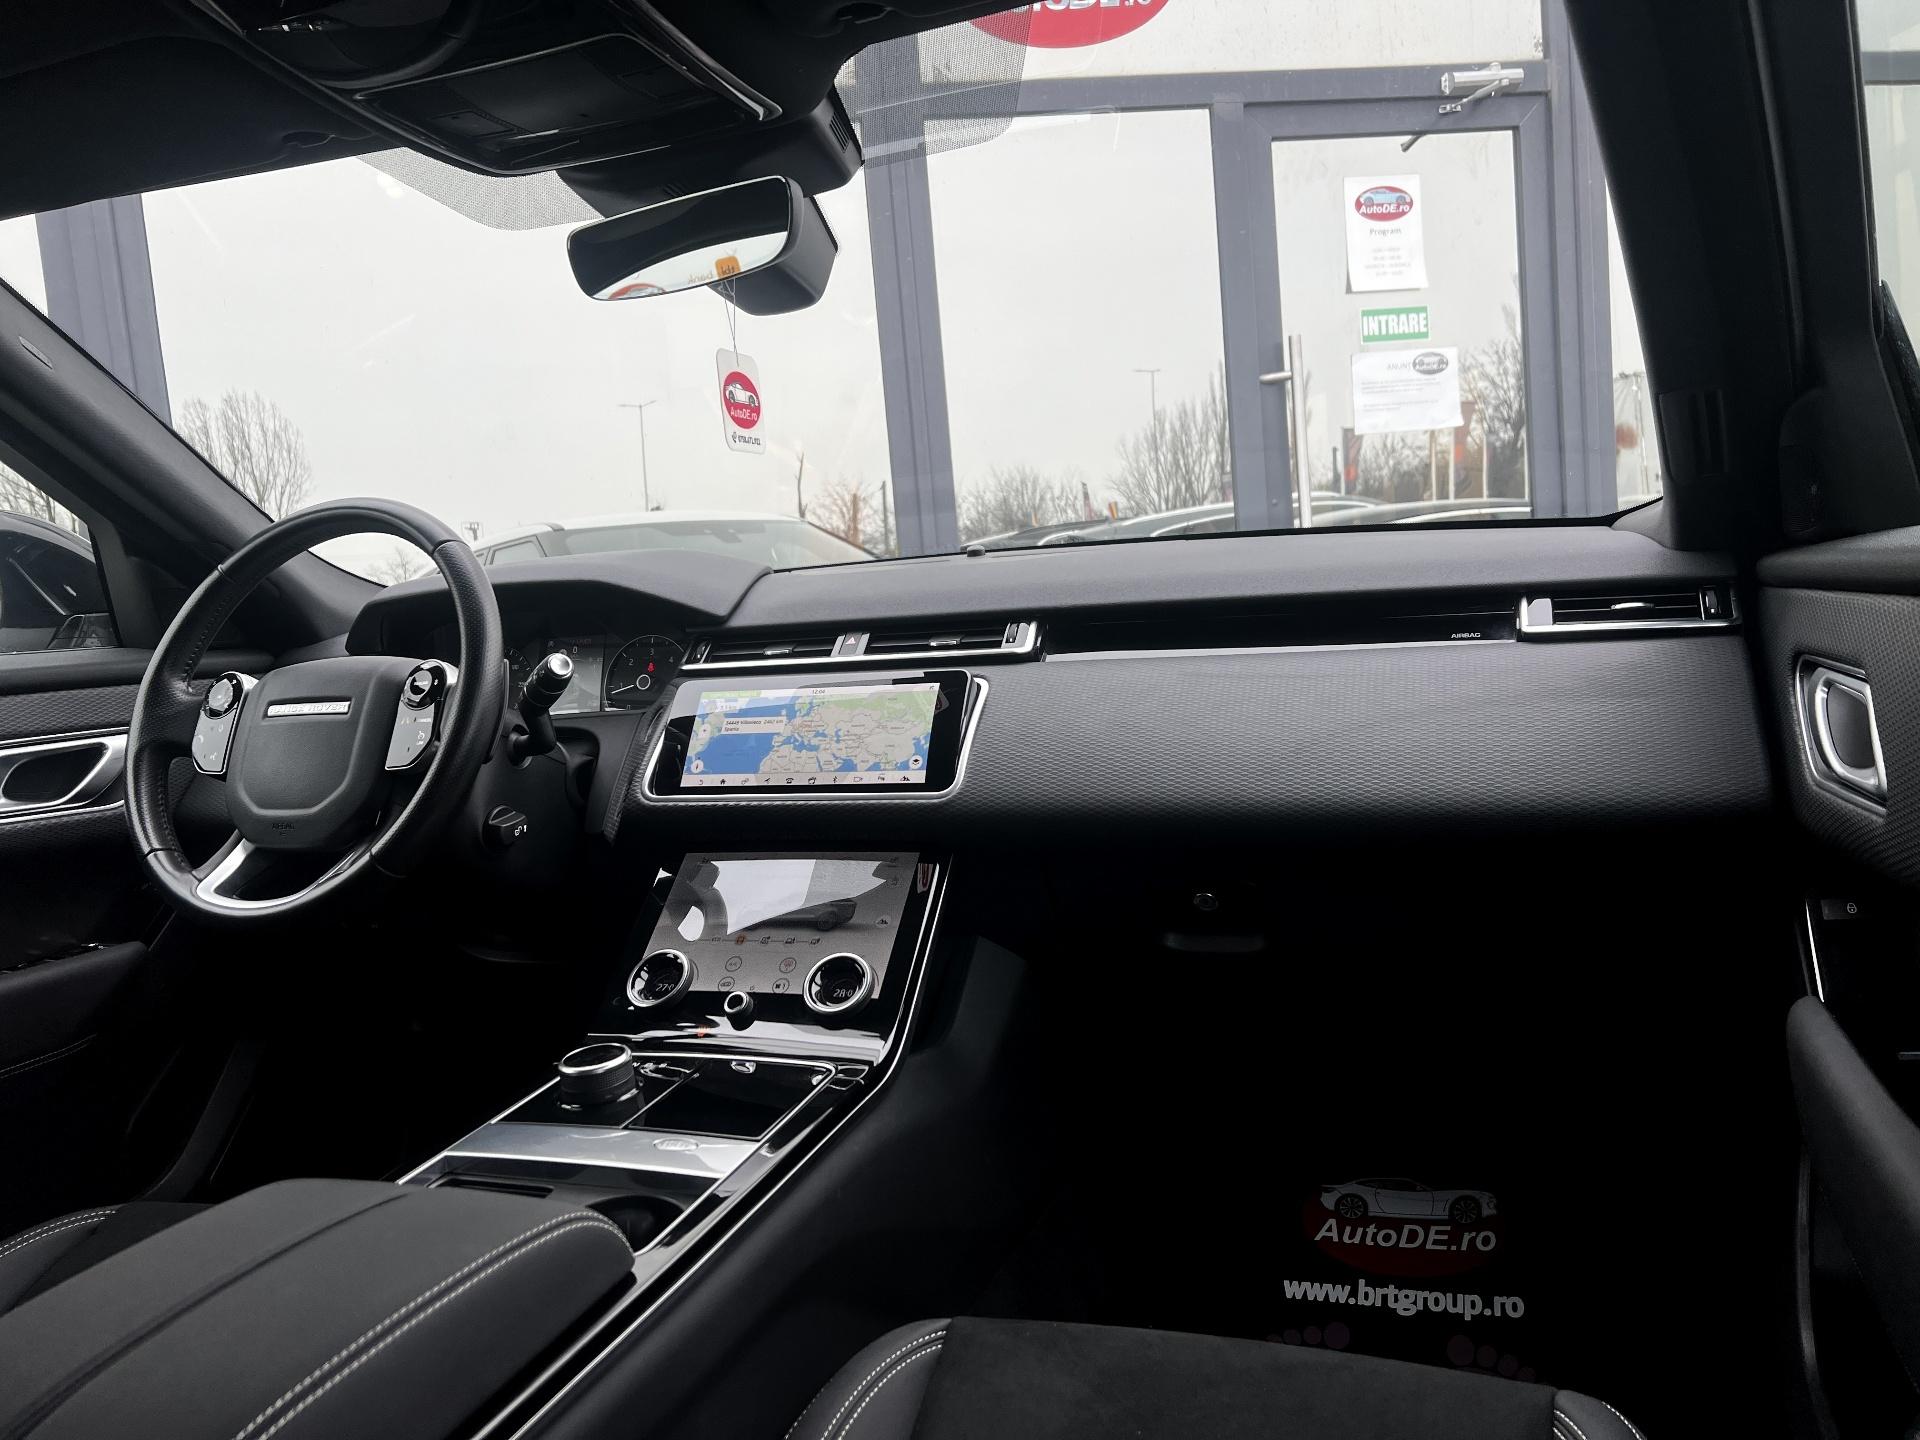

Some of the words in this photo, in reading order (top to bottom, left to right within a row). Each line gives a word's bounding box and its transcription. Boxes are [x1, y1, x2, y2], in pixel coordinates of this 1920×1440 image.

[1359, 203, 1410, 215] AutoDE.ro
[1362, 313, 1427, 336] INTRARE
[730, 406, 758, 421] AutoDE.ro
[1314, 1218, 1496, 1251] AutoDE.ro
[1283, 1279, 1525, 1321] www.brtgroup.ro
